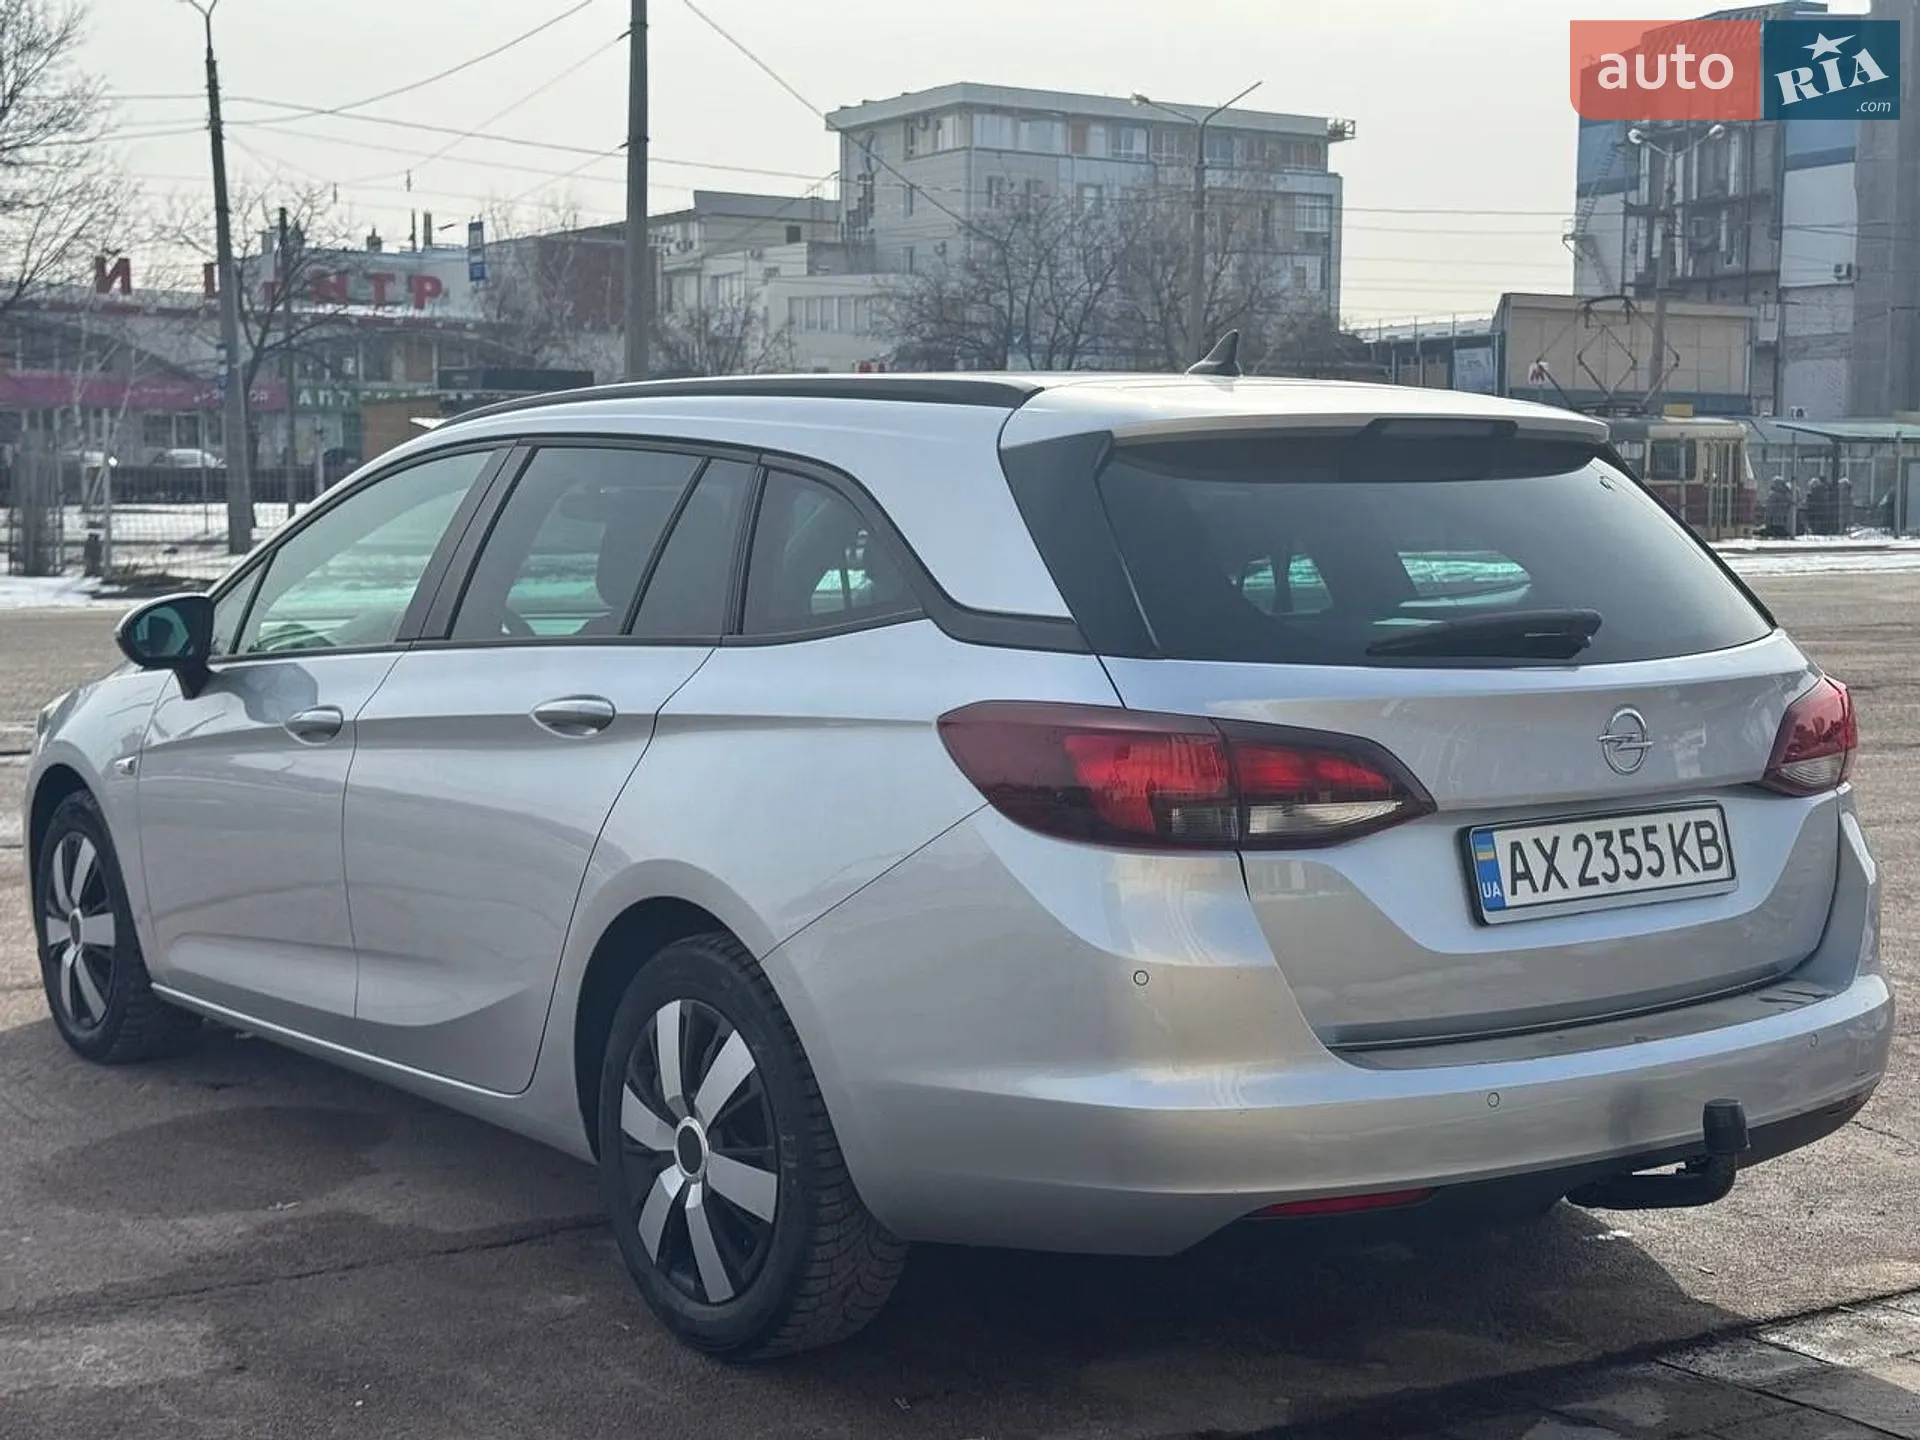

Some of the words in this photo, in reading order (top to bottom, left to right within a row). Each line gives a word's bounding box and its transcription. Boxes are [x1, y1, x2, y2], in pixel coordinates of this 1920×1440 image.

[1509, 835, 1570, 896] AX
[1572, 825, 1665, 887] 2355
[1667, 820, 1725, 876] KB
[1482, 882, 1502, 899] UA
